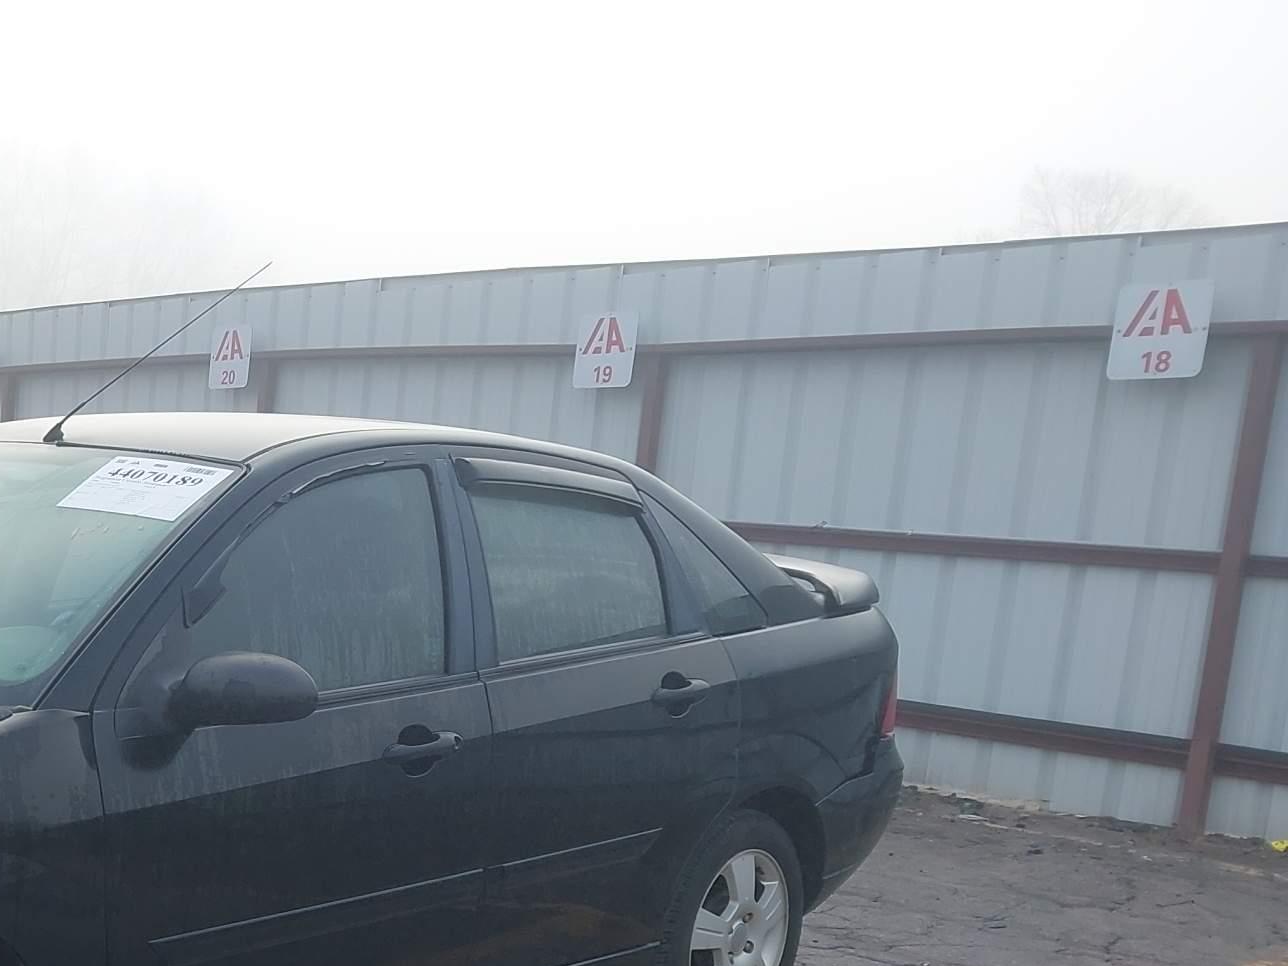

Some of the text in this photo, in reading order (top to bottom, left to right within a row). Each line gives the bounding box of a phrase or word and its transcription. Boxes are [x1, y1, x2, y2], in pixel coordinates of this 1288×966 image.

[1141, 350, 1172, 374] 18
[221, 370, 236, 385] 20
[593, 365, 613, 383] 19
[108, 467, 204, 487] 44070189
